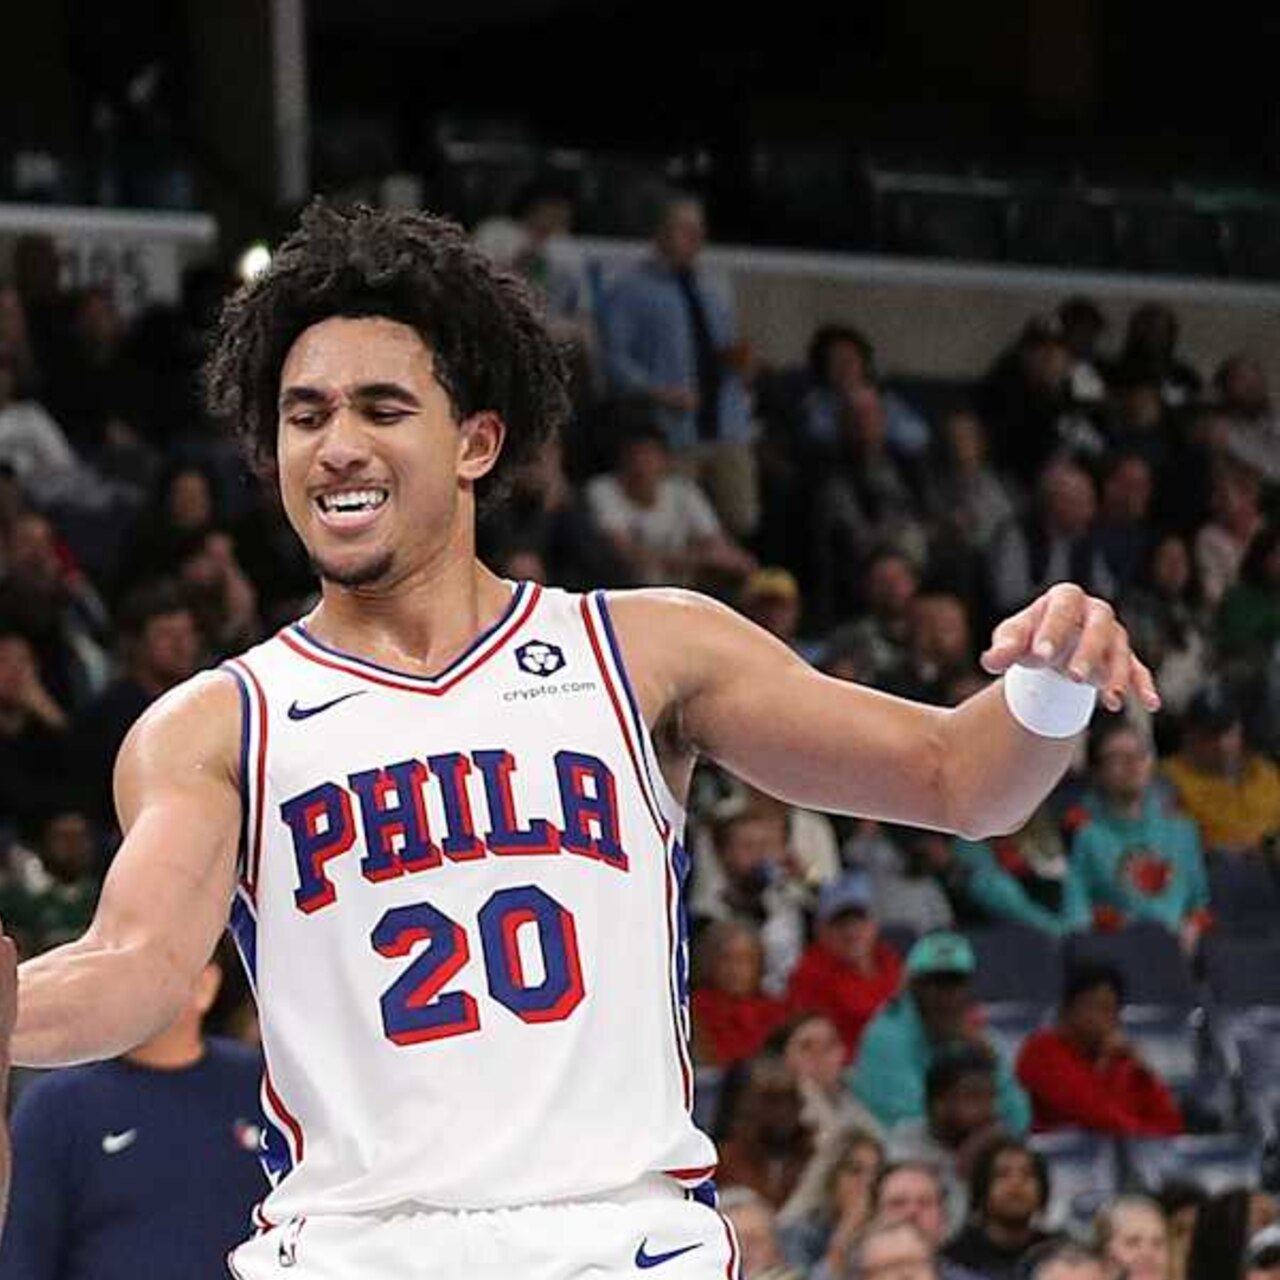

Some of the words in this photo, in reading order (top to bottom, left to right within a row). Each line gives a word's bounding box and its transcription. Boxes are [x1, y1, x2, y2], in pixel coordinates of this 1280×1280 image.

[502, 682, 596, 702] crypto.com
[279, 749, 630, 916] PHILA
[370, 884, 587, 1047] 20
